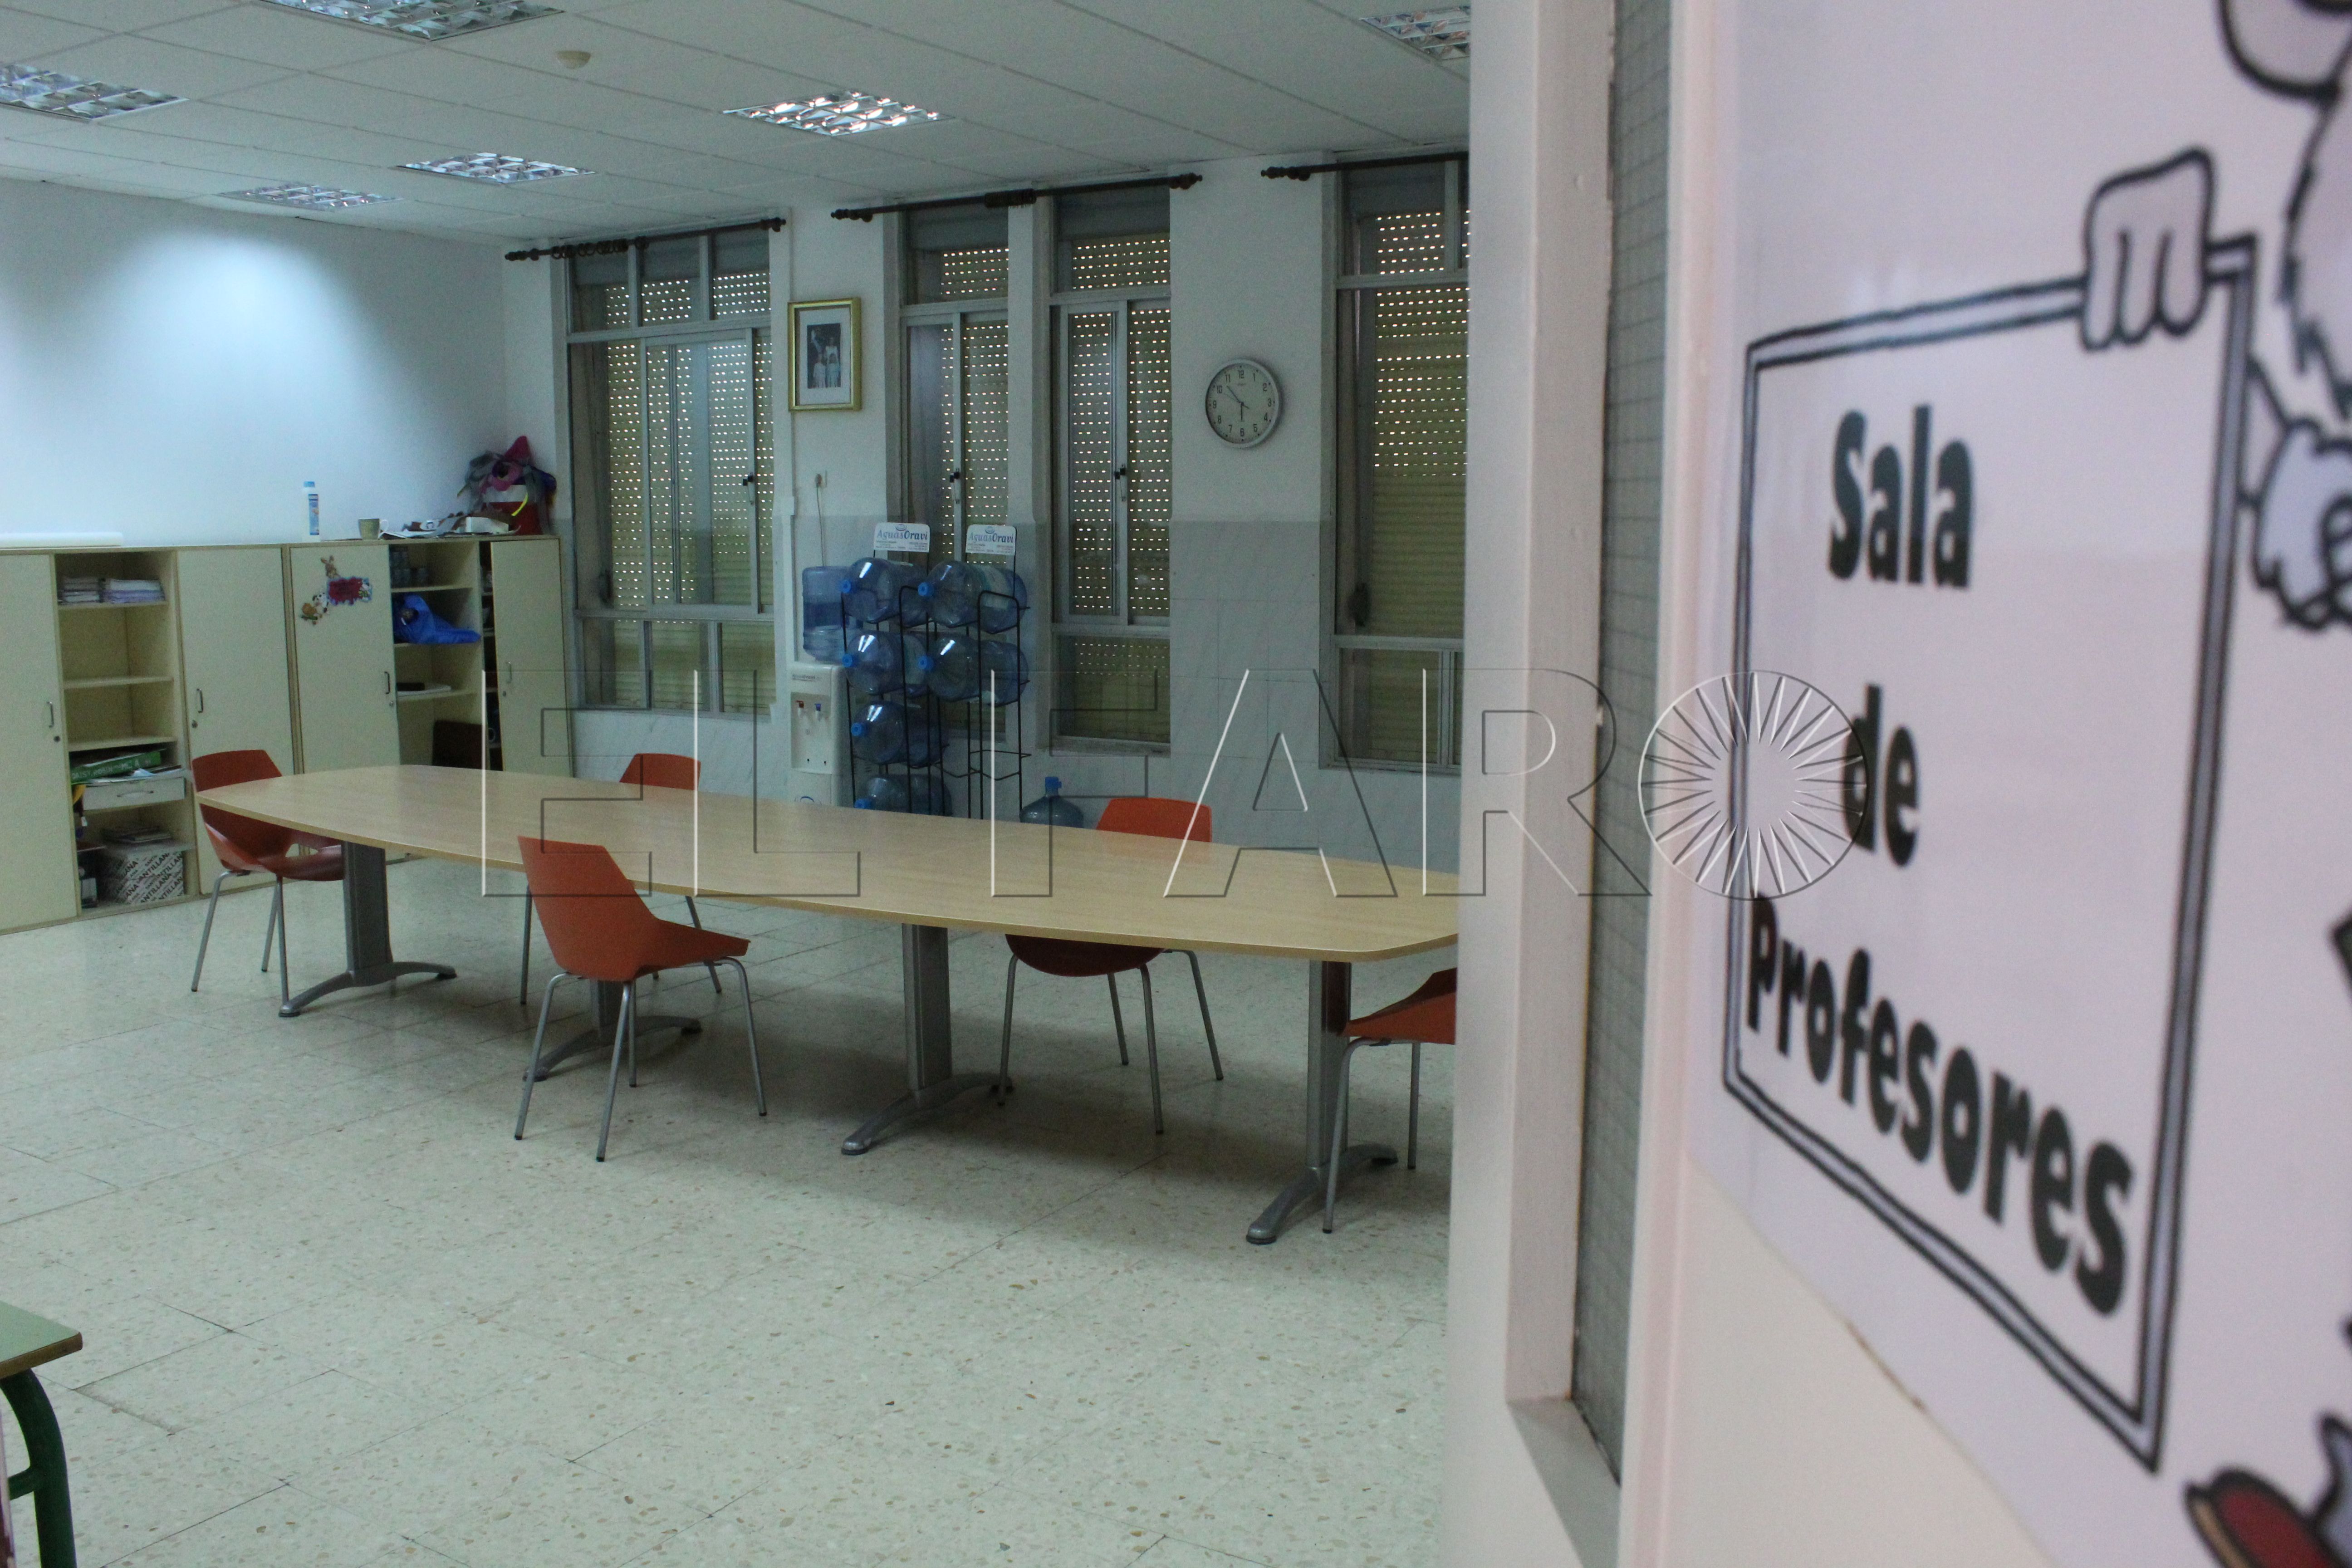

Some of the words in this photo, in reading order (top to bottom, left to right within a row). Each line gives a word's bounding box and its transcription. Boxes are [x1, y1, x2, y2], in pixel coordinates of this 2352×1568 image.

[1225, 374, 1231, 382] 11
[1238, 370, 1245, 379] 12
[1253, 373, 1256, 382] 1
[1217, 386, 1223, 394] 10
[1263, 383, 1267, 392] 2
[1213, 400, 1217, 409] 9
[1268, 398, 1272, 407] 3
[1217, 415, 1221, 424] 8
[1264, 412, 1268, 421] 4
[1229, 425, 1232, 433] 7
[1240, 428, 1245, 436] 6
[1253, 424, 1258, 432] 5
[1827, 405, 1974, 590] Sala
[1838, 682, 1920, 868] de
[1748, 889, 2135, 1318] Profesores
